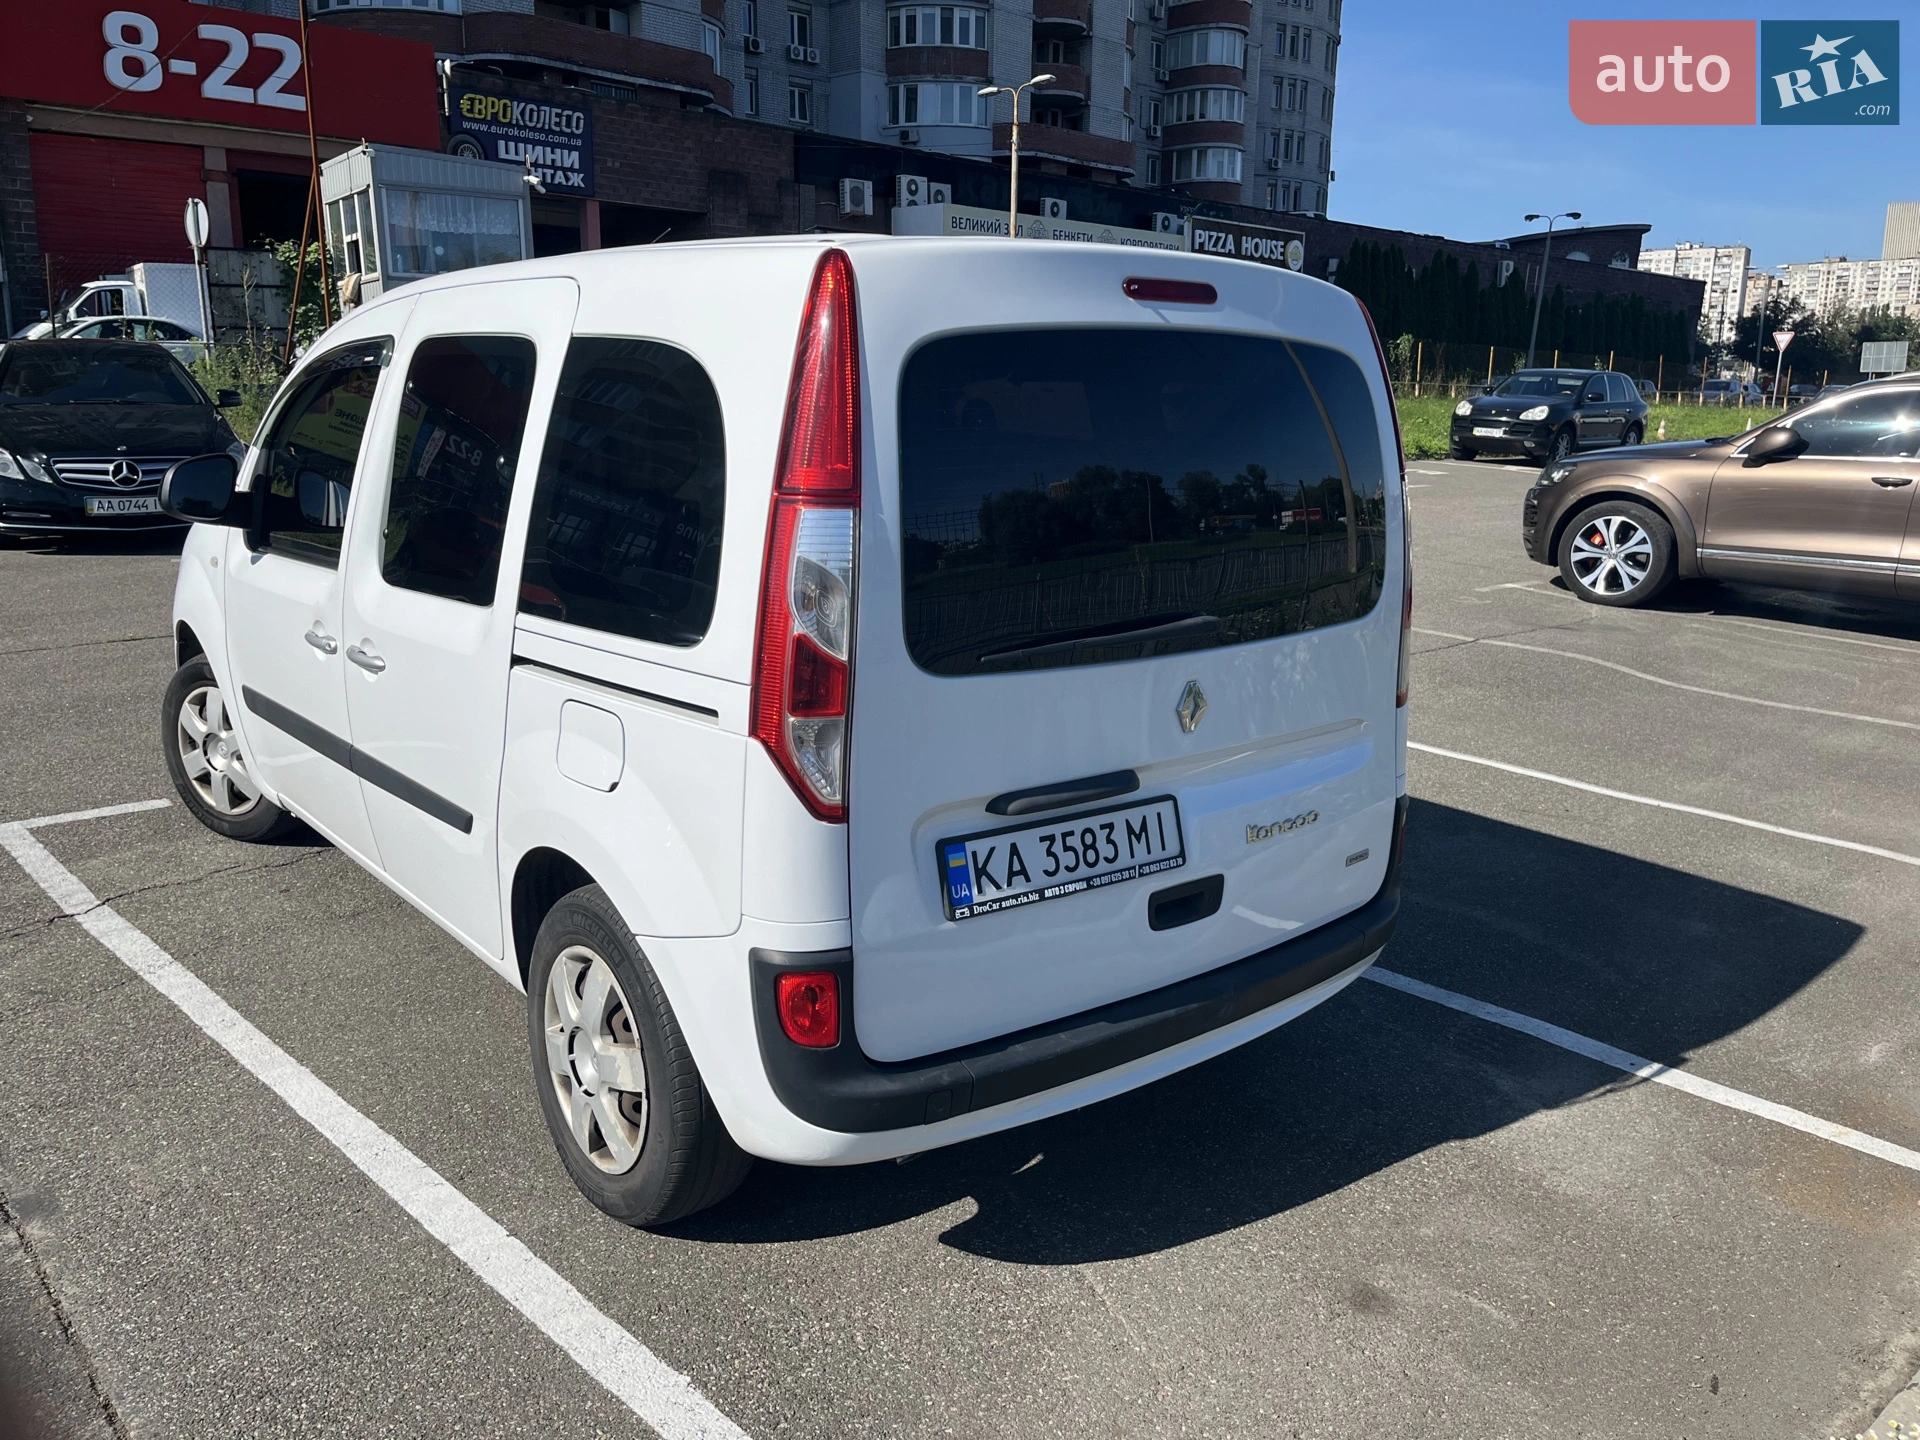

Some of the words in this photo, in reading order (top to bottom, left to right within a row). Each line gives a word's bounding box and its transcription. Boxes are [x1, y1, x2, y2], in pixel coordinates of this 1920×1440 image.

[102, 10, 307, 112] 8-22
[462, 120, 583, 147] www.eurokoleso.com.ua
[497, 139, 580, 170] ШИНИ
[951, 216, 1002, 235] ВЕЛИКИЙ
[1003, 223, 1024, 237] ЗЛ
[1052, 229, 1094, 243] БЕНКЕТИ
[1193, 229, 1236, 255] PIZZA
[1240, 236, 1285, 261] HOUSE
[96, 500, 116, 512] AA
[118, 499, 149, 512] 0744
[970, 842, 1032, 896] KA
[1038, 821, 1119, 878] 3583
[1125, 811, 1166, 860] MI
[951, 883, 970, 899] UA
[973, 902, 1001, 915] DroCar
[1001, 892, 1040, 908] auto.ria.biz
